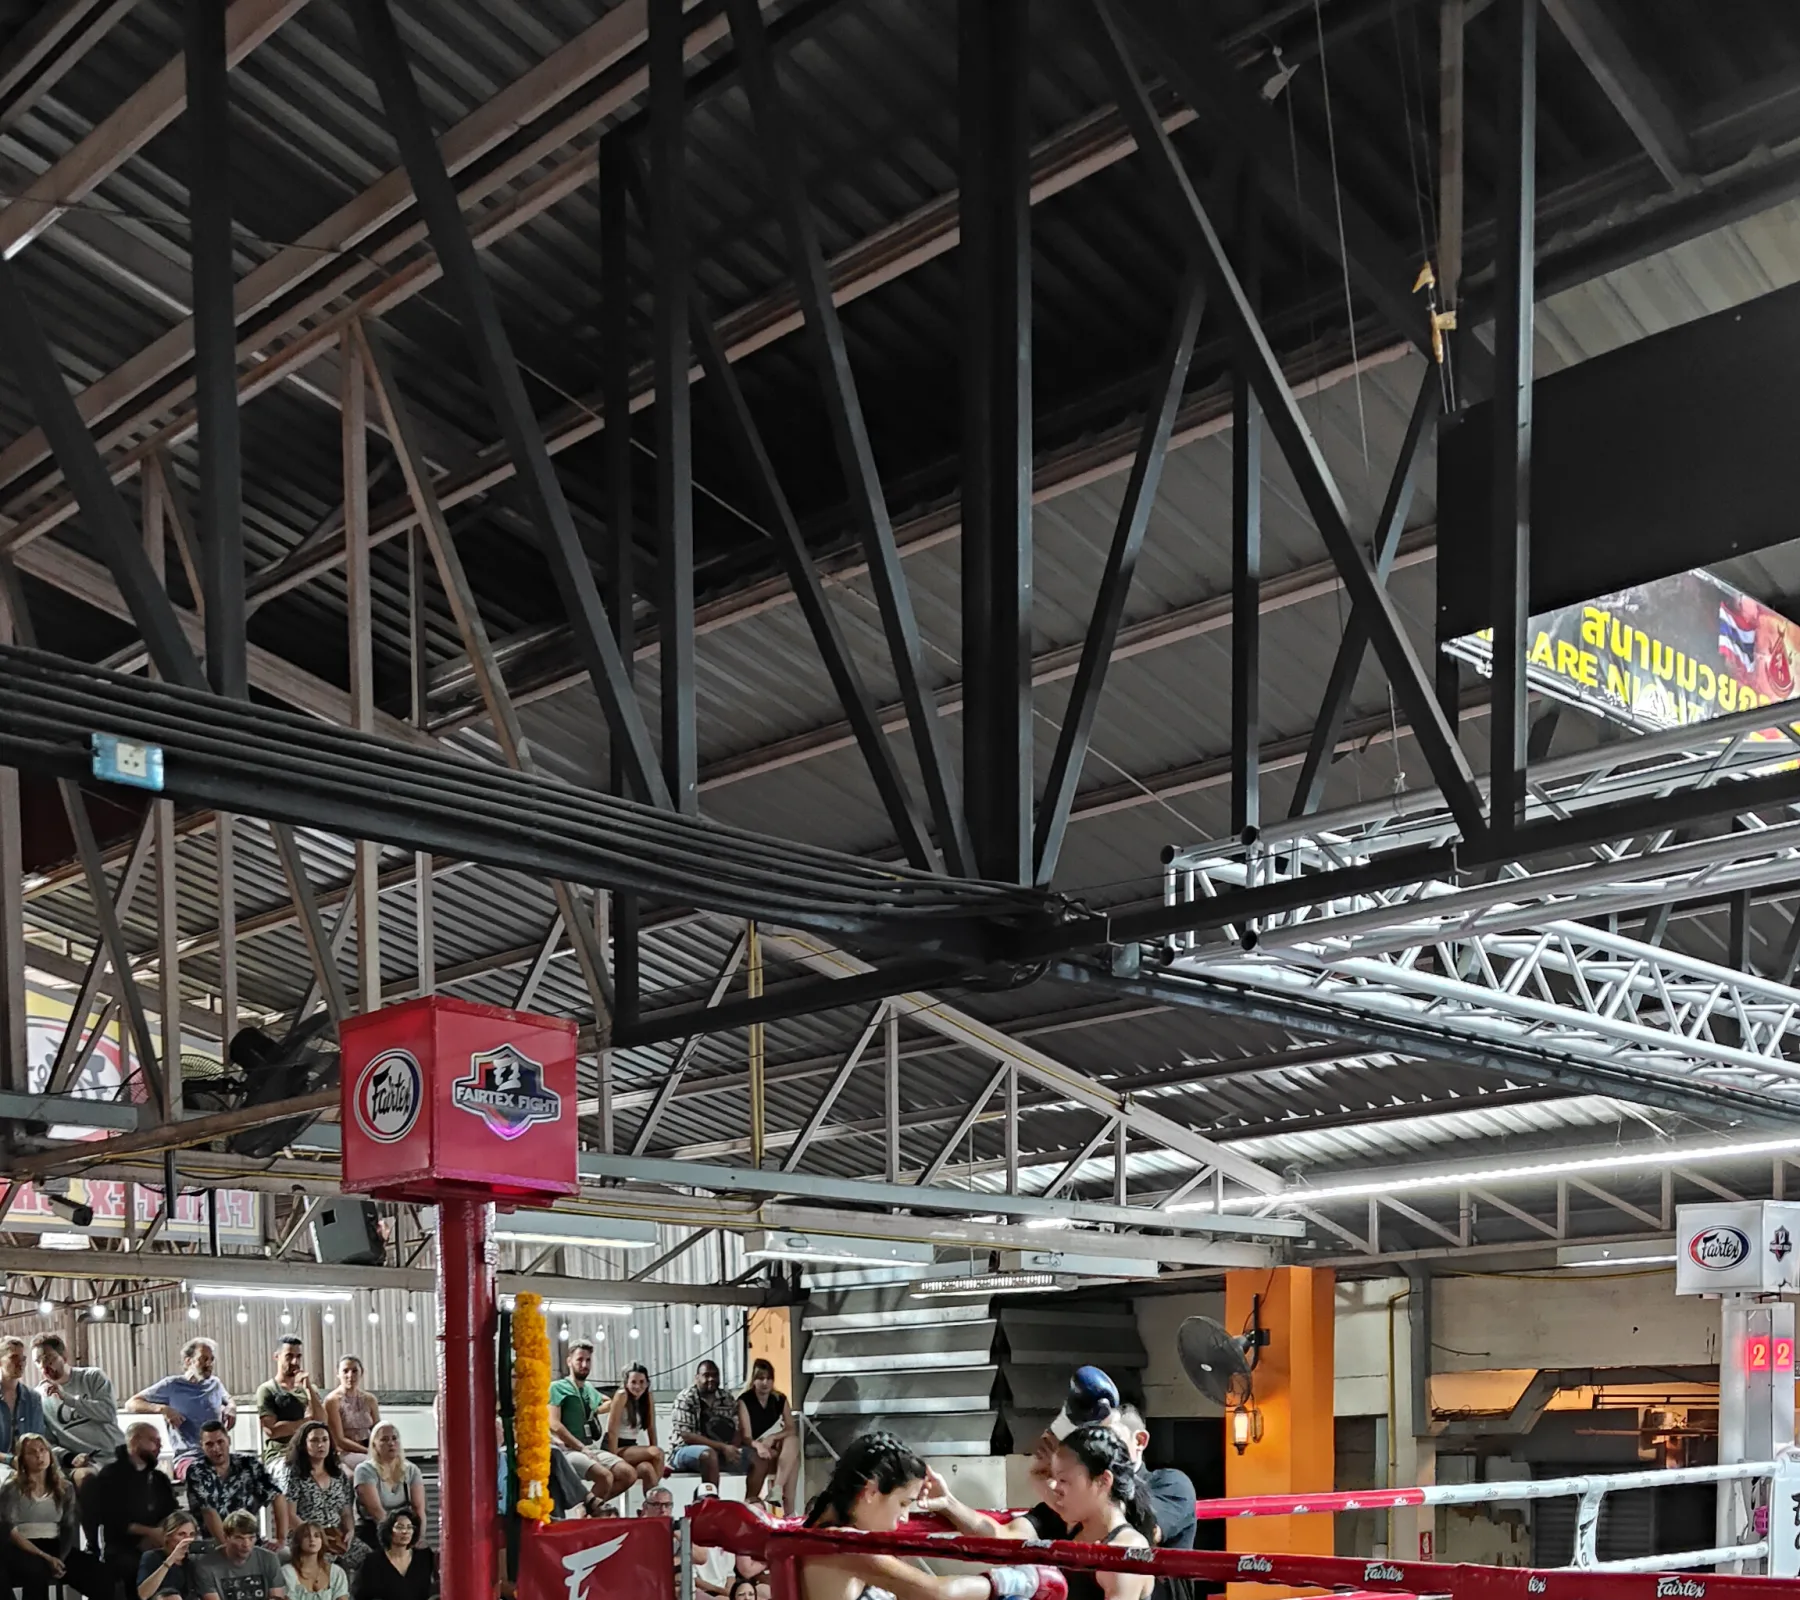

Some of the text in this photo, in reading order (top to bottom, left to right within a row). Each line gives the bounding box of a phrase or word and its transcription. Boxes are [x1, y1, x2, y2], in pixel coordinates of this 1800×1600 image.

[1526, 631, 1598, 687] ARE
[371, 1065, 412, 1121] Fairtex
[455, 1086, 558, 1113] FAIRTEX FIGHT
[1701, 1232, 1740, 1260] Fairtex
[1753, 1344, 1766, 1366] 2
[1777, 1343, 1790, 1366] 2
[1237, 1554, 1273, 1573] Fairtex
[1363, 1562, 1404, 1583] Fairtex
[1656, 1575, 1705, 1599] Fairtex
